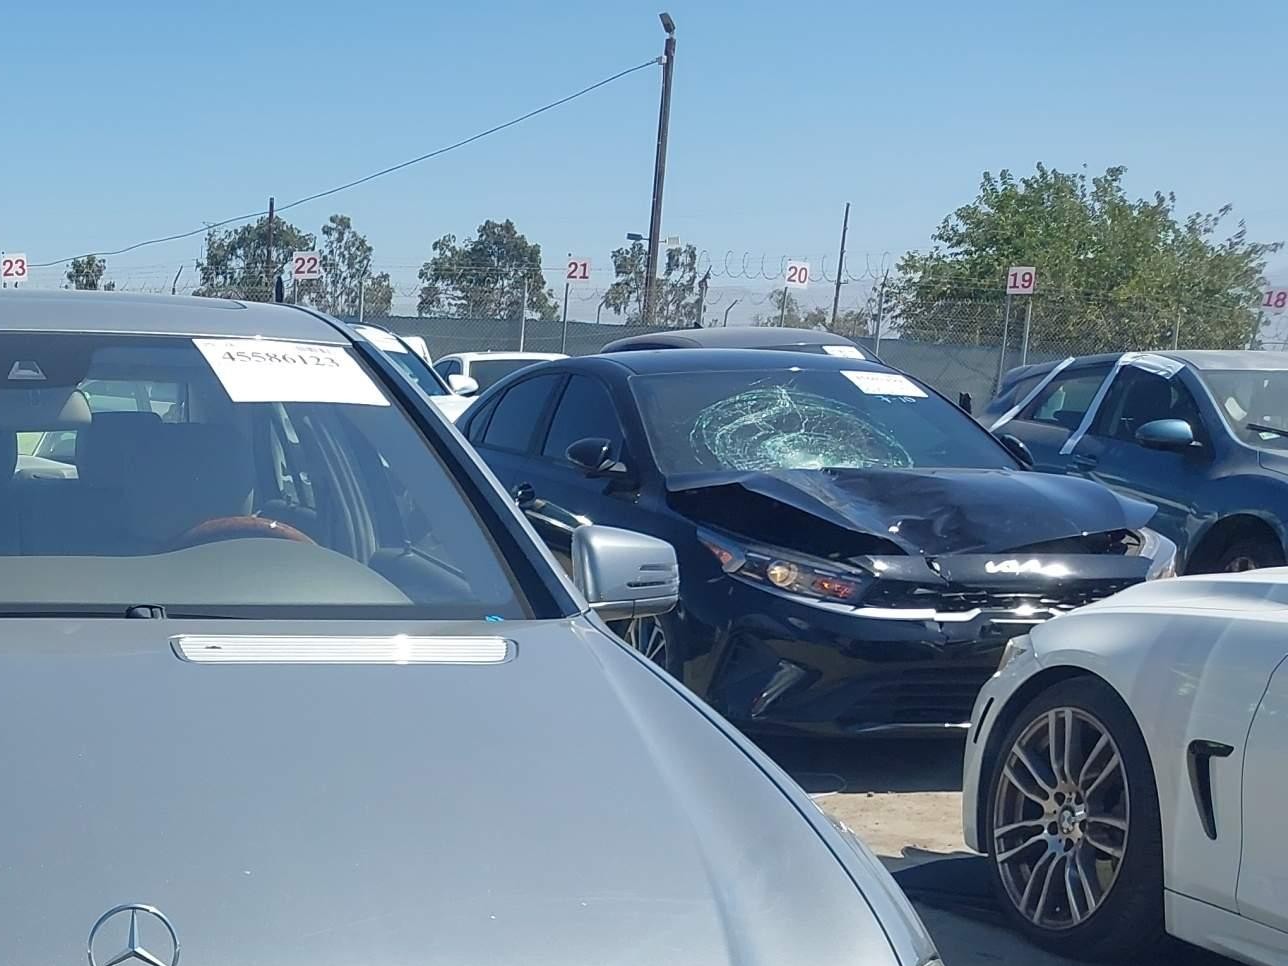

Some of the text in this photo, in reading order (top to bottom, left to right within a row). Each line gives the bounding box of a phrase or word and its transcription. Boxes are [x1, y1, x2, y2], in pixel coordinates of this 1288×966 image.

[3, 259, 25, 277] 23
[295, 257, 317, 274] 22
[567, 262, 589, 279] 21
[787, 266, 807, 283] 20
[1009, 272, 1032, 289] 19
[1263, 291, 1287, 308] 18
[221, 351, 340, 368] 45586123
